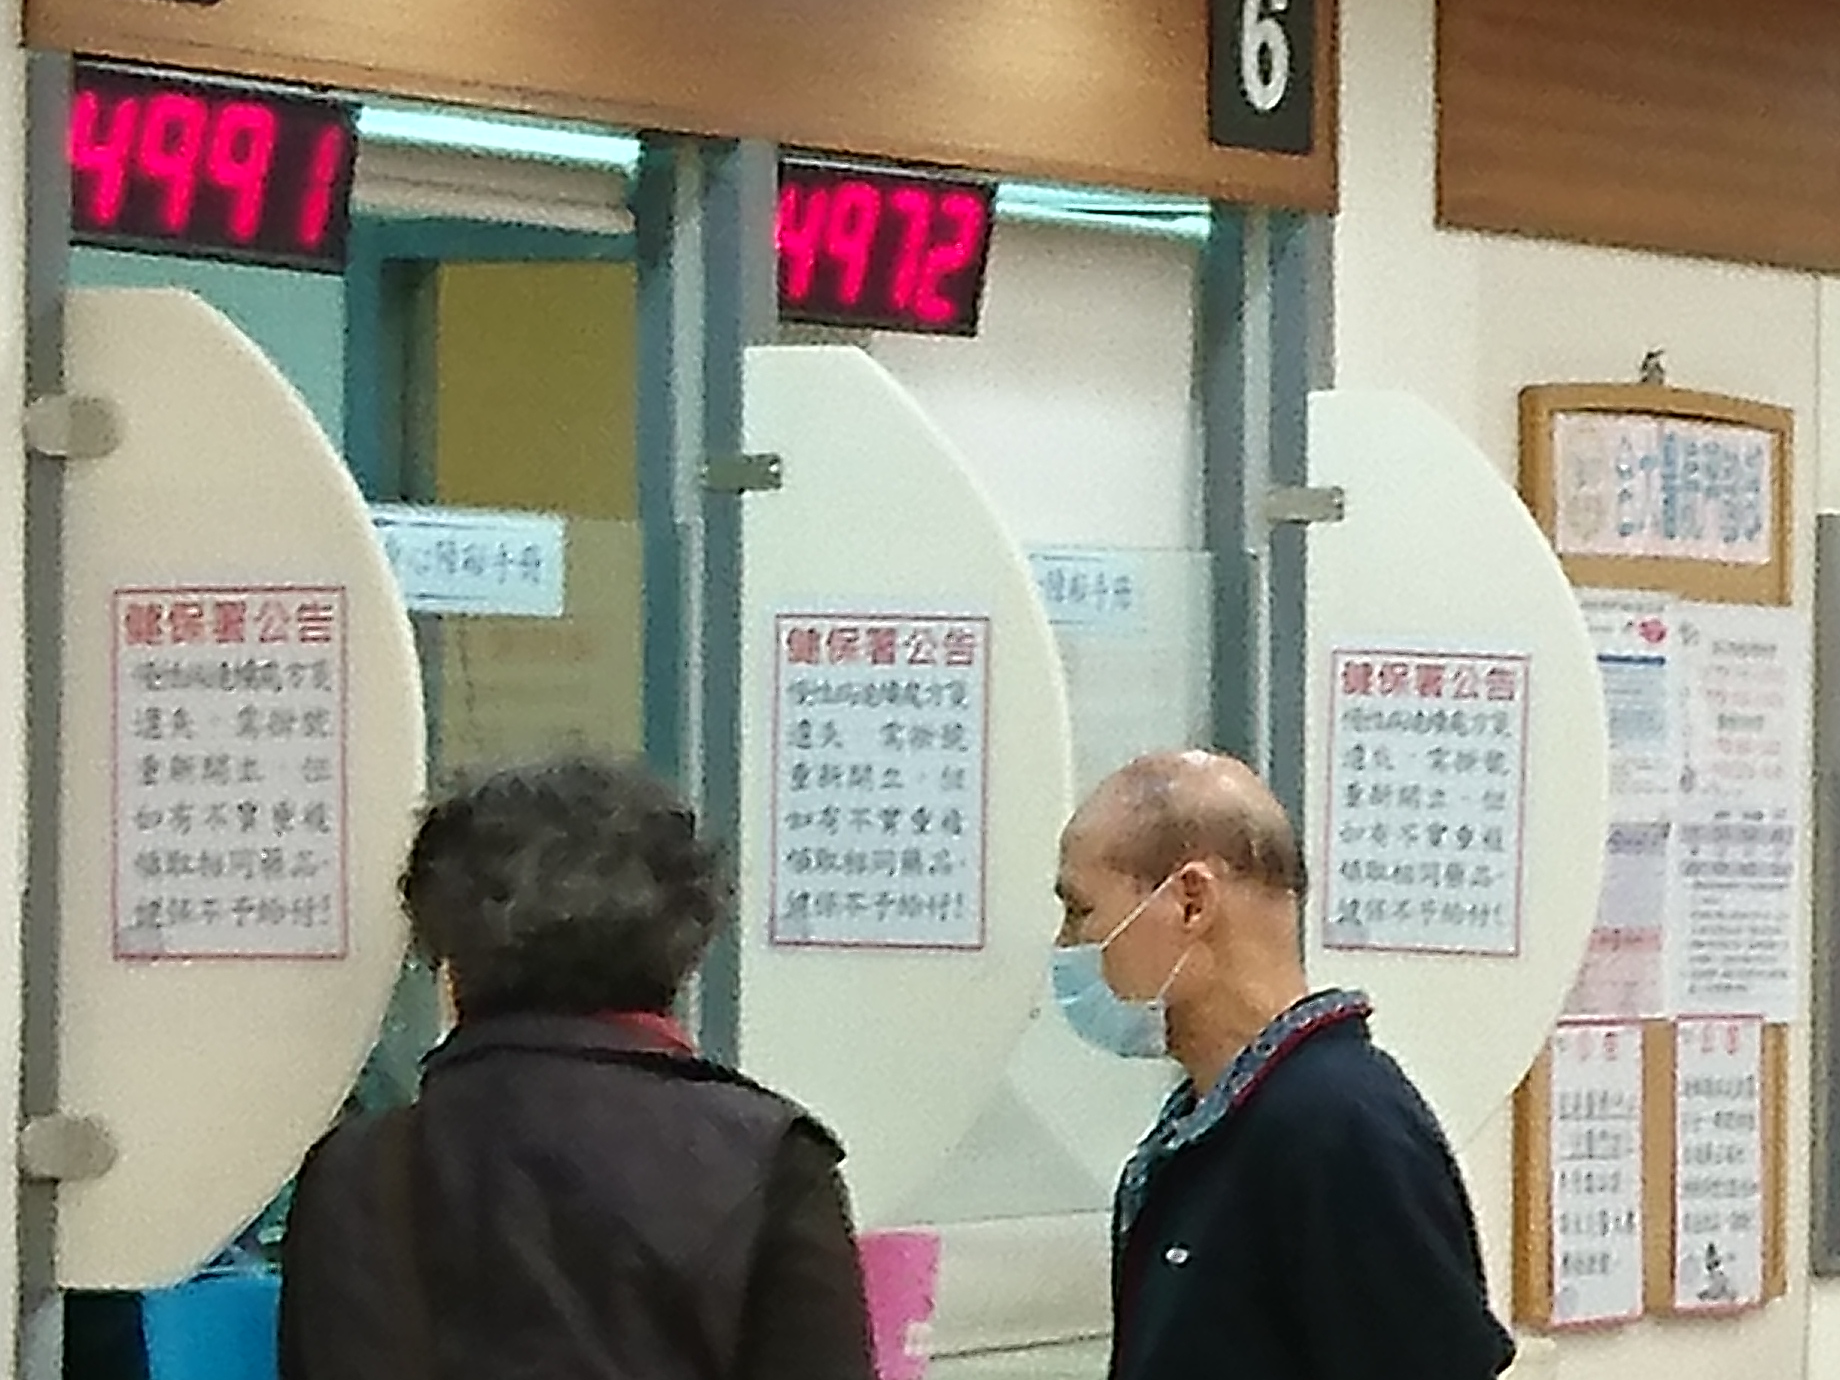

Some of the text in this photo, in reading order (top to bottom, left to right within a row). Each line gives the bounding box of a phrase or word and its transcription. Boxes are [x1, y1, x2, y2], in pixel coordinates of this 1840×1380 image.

[68, 89, 344, 250] 4991
[775, 180, 984, 322] 4972
[125, 599, 335, 646] 健保署公告
[786, 626, 977, 666] 健保署公告
[1341, 661, 1517, 702] 健保署公告
